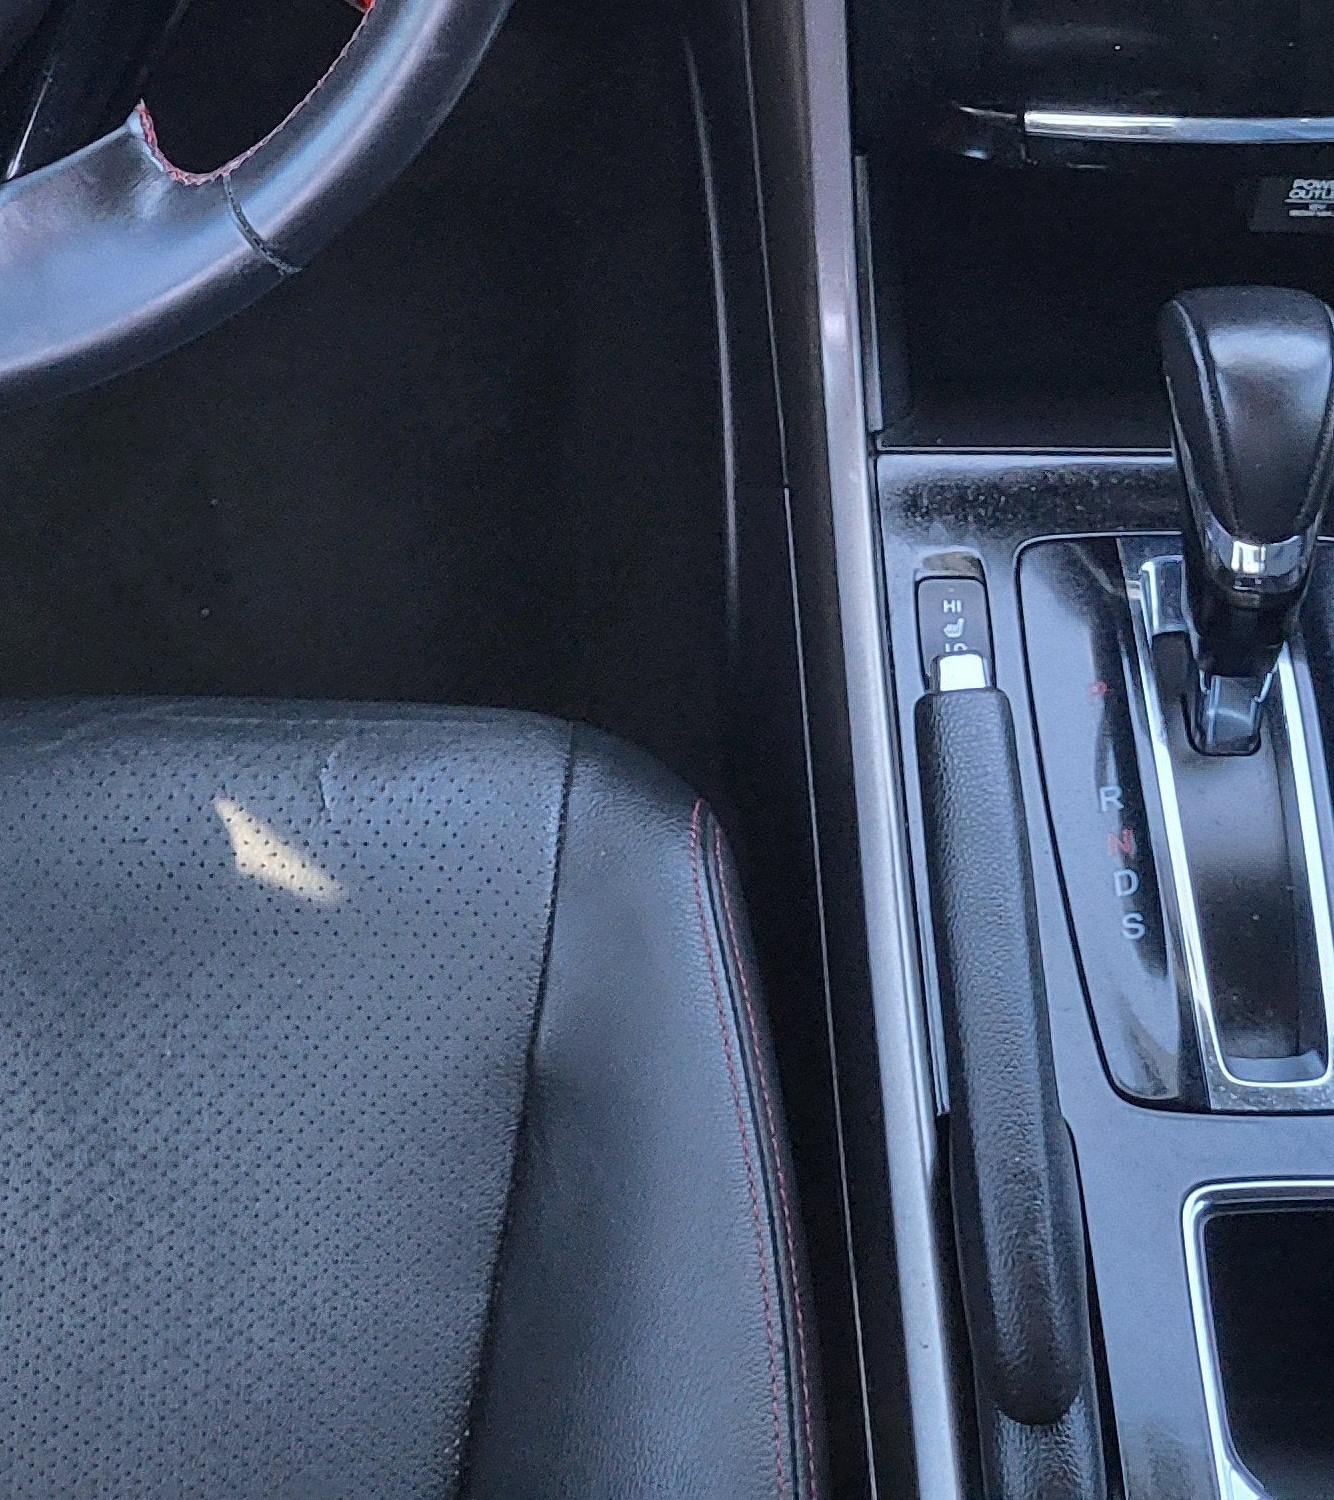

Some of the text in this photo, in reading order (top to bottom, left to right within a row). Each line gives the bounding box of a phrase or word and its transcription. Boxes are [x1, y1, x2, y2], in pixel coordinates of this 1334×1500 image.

[942, 599, 963, 614] HI
[1099, 786, 1125, 812] R
[1107, 828, 1136, 858] N
[1113, 869, 1139, 897] D
[1122, 912, 1146, 940] S
